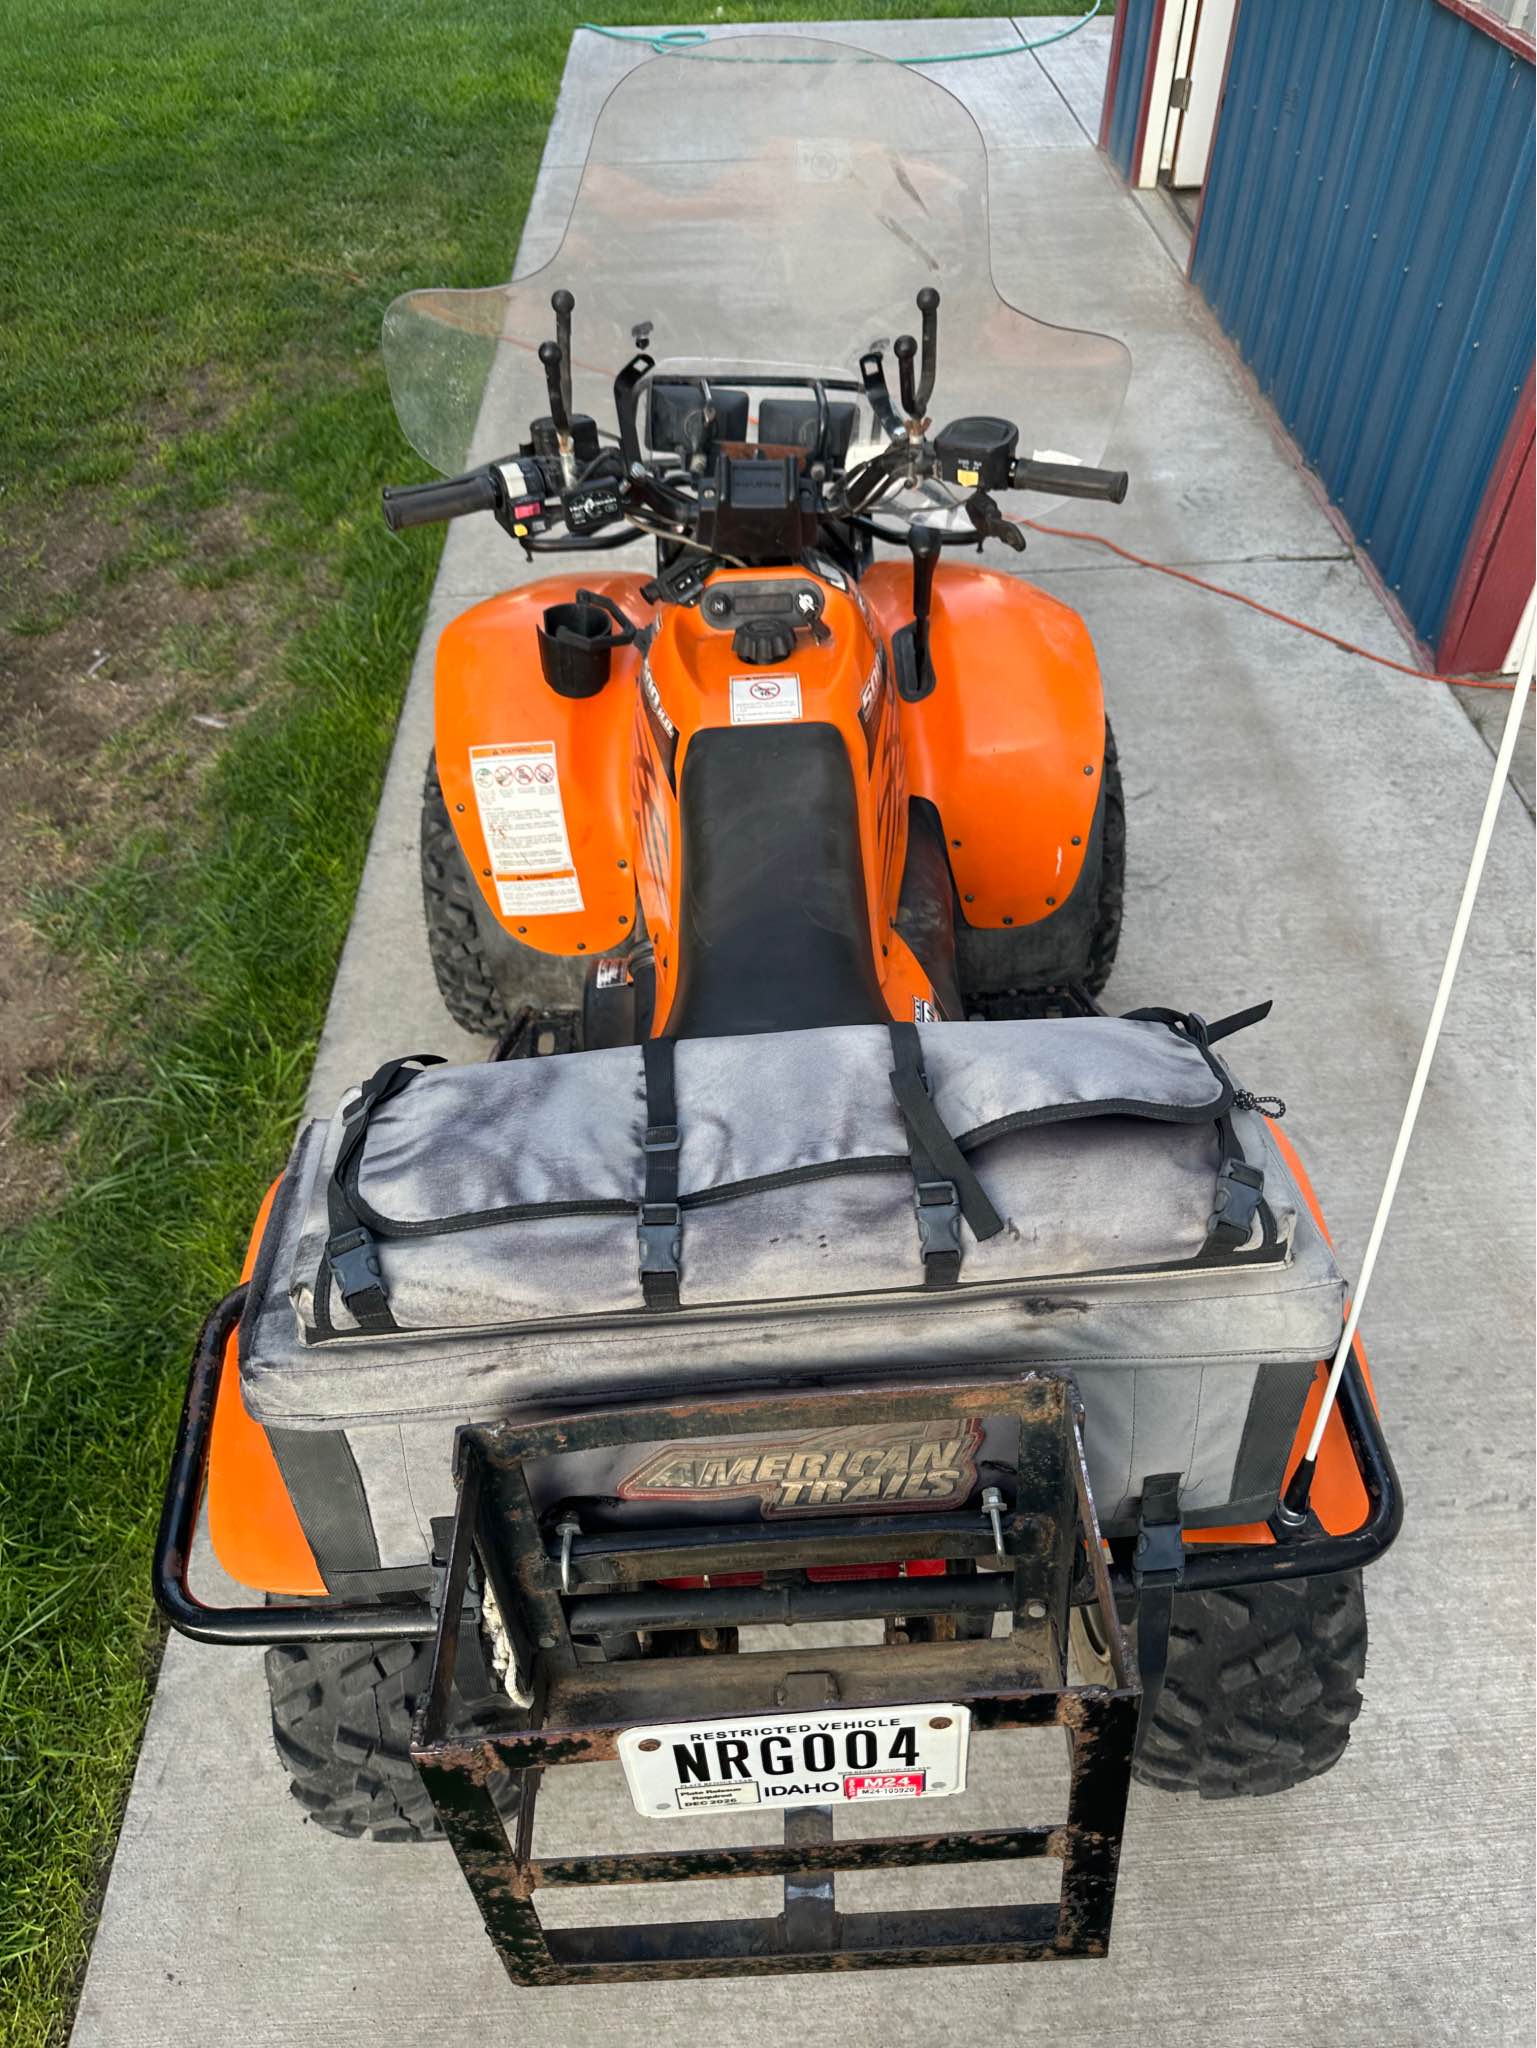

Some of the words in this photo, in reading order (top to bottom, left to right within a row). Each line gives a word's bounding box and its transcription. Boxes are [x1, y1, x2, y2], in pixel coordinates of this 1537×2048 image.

[646, 1439, 961, 1488] AMERICAN
[780, 1470, 960, 1505] TRAILS
[690, 1724, 812, 1742] RESTRICTED
[817, 1718, 901, 1731] VEHICLE
[672, 1726, 920, 1784] NRG004
[764, 1782, 839, 1797] IDAHO
[863, 1776, 911, 1787] M24
